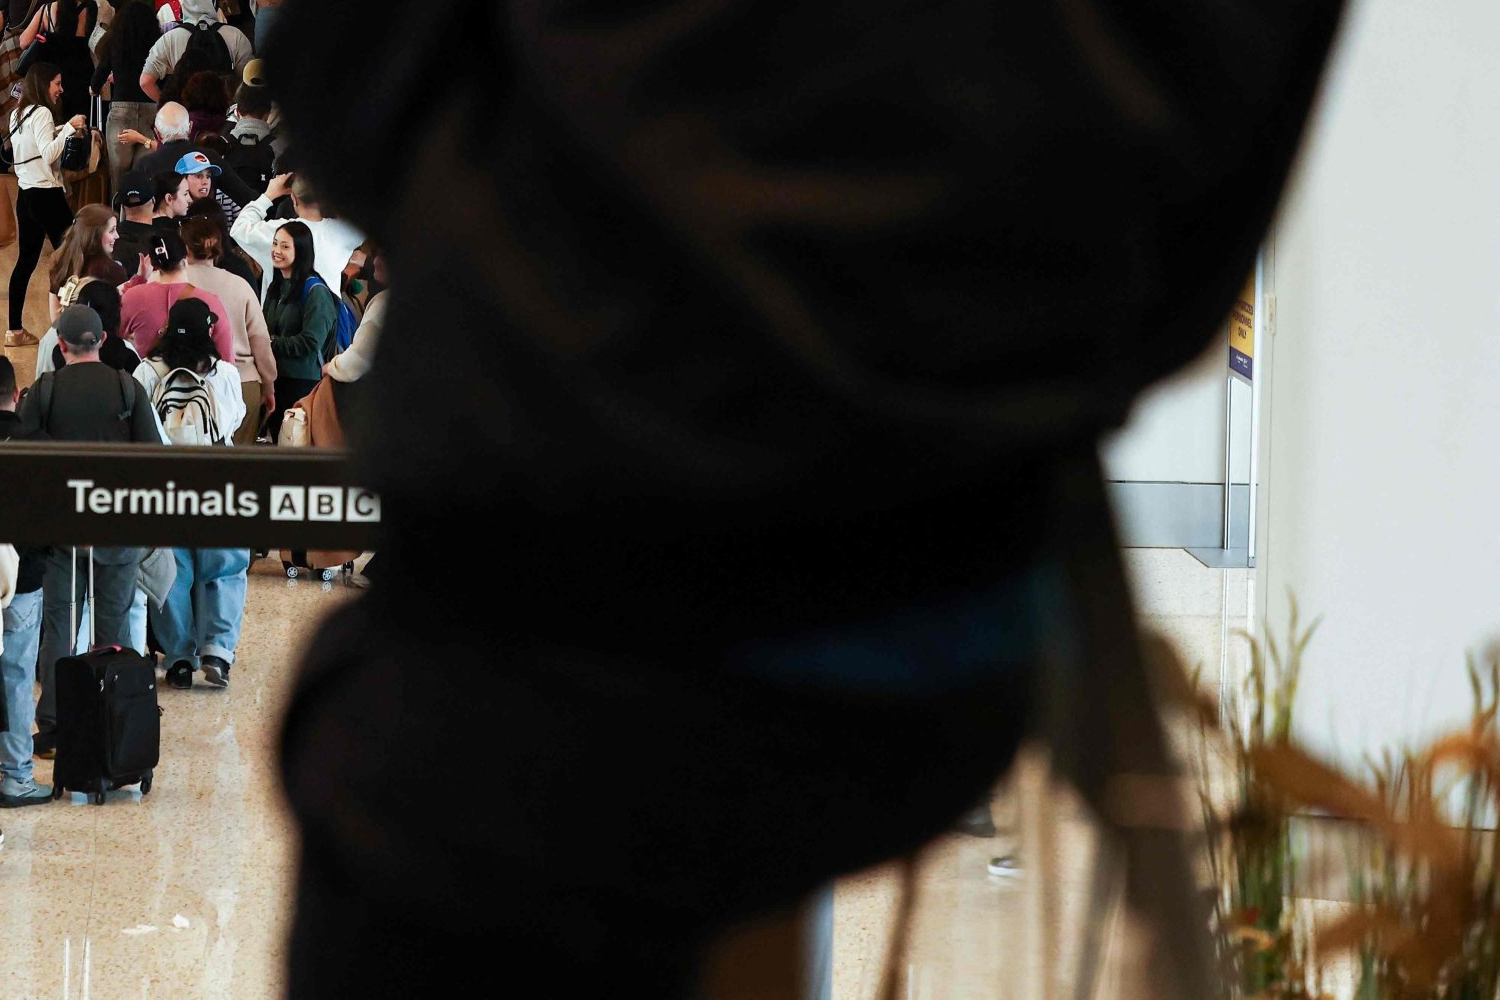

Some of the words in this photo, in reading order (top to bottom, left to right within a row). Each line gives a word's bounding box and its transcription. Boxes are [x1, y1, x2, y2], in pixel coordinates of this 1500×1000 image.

[67, 479, 259, 517] Terminals
[274, 489, 300, 518] A
[312, 490, 338, 518] B
[350, 491, 376, 519] C
